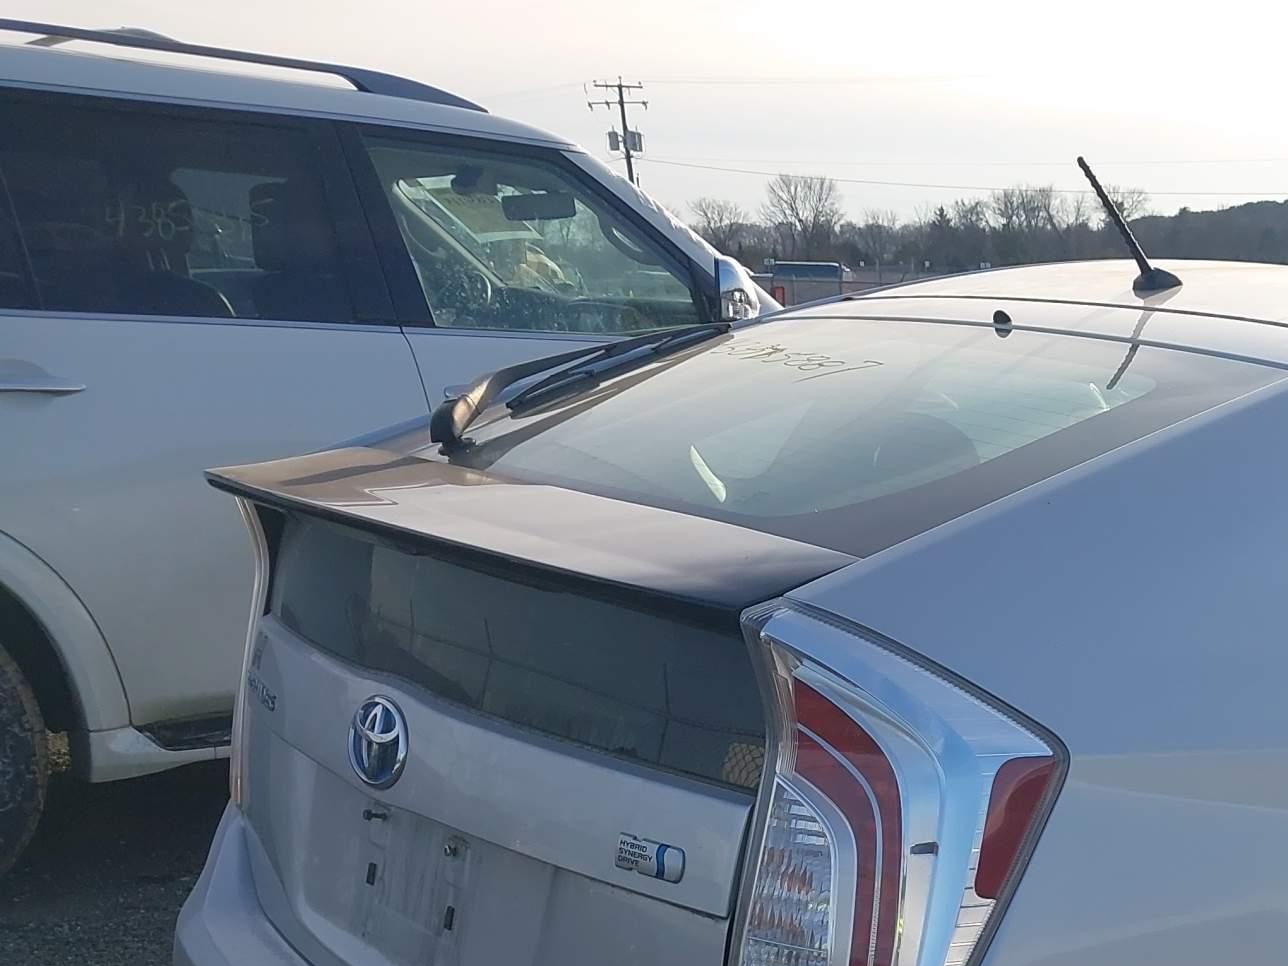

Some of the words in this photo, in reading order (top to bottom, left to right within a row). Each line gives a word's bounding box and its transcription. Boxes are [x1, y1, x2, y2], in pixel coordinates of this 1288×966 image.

[620, 839, 648, 853] HYBRID
[617, 854, 641, 867] DRIVE
[619, 847, 653, 863] SYNERGY
